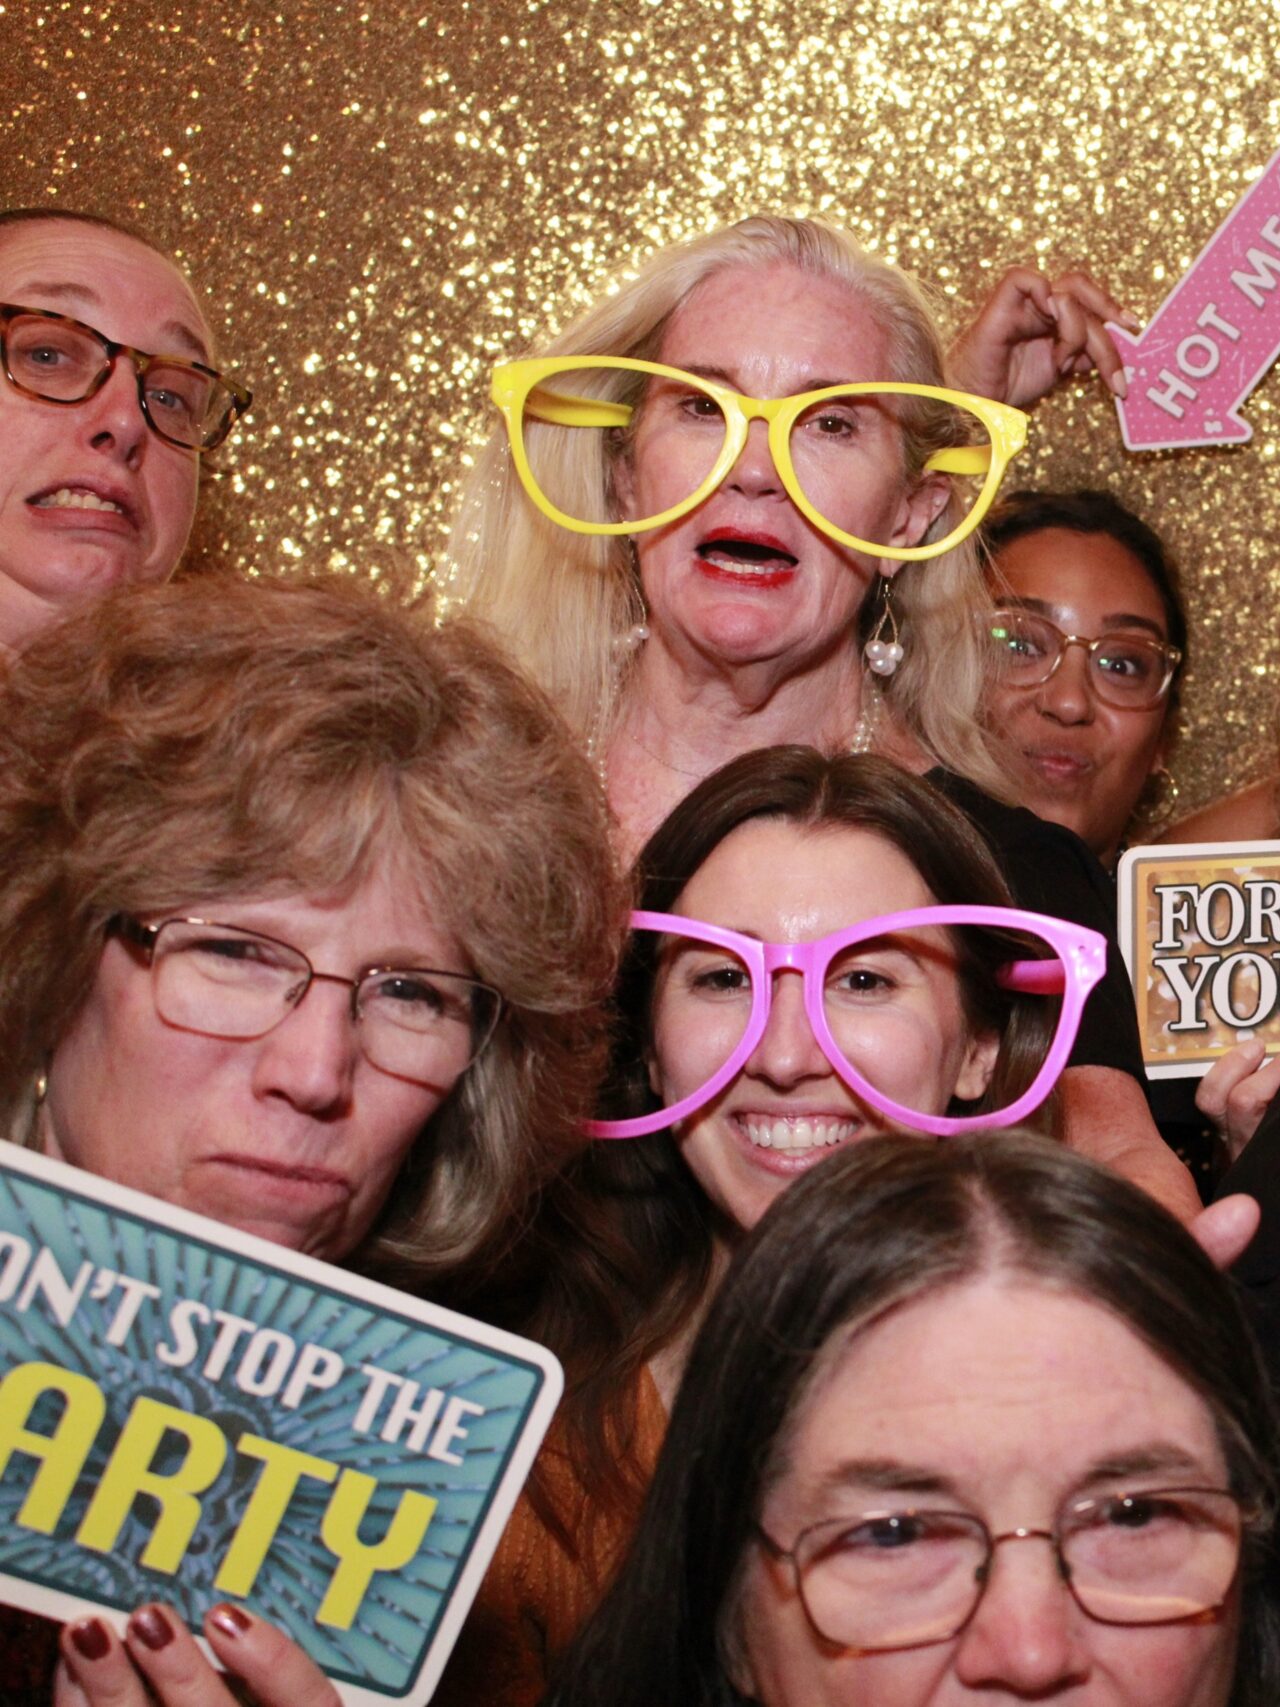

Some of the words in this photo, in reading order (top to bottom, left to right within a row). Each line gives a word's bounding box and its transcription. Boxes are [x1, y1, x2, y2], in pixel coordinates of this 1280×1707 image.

[1146, 303, 1241, 419] HOT
[0, 1230, 161, 1346] ON'T
[156, 1300, 345, 1409] STOP
[352, 1363, 485, 1467] THE
[0, 1360, 439, 1631] ARTY
